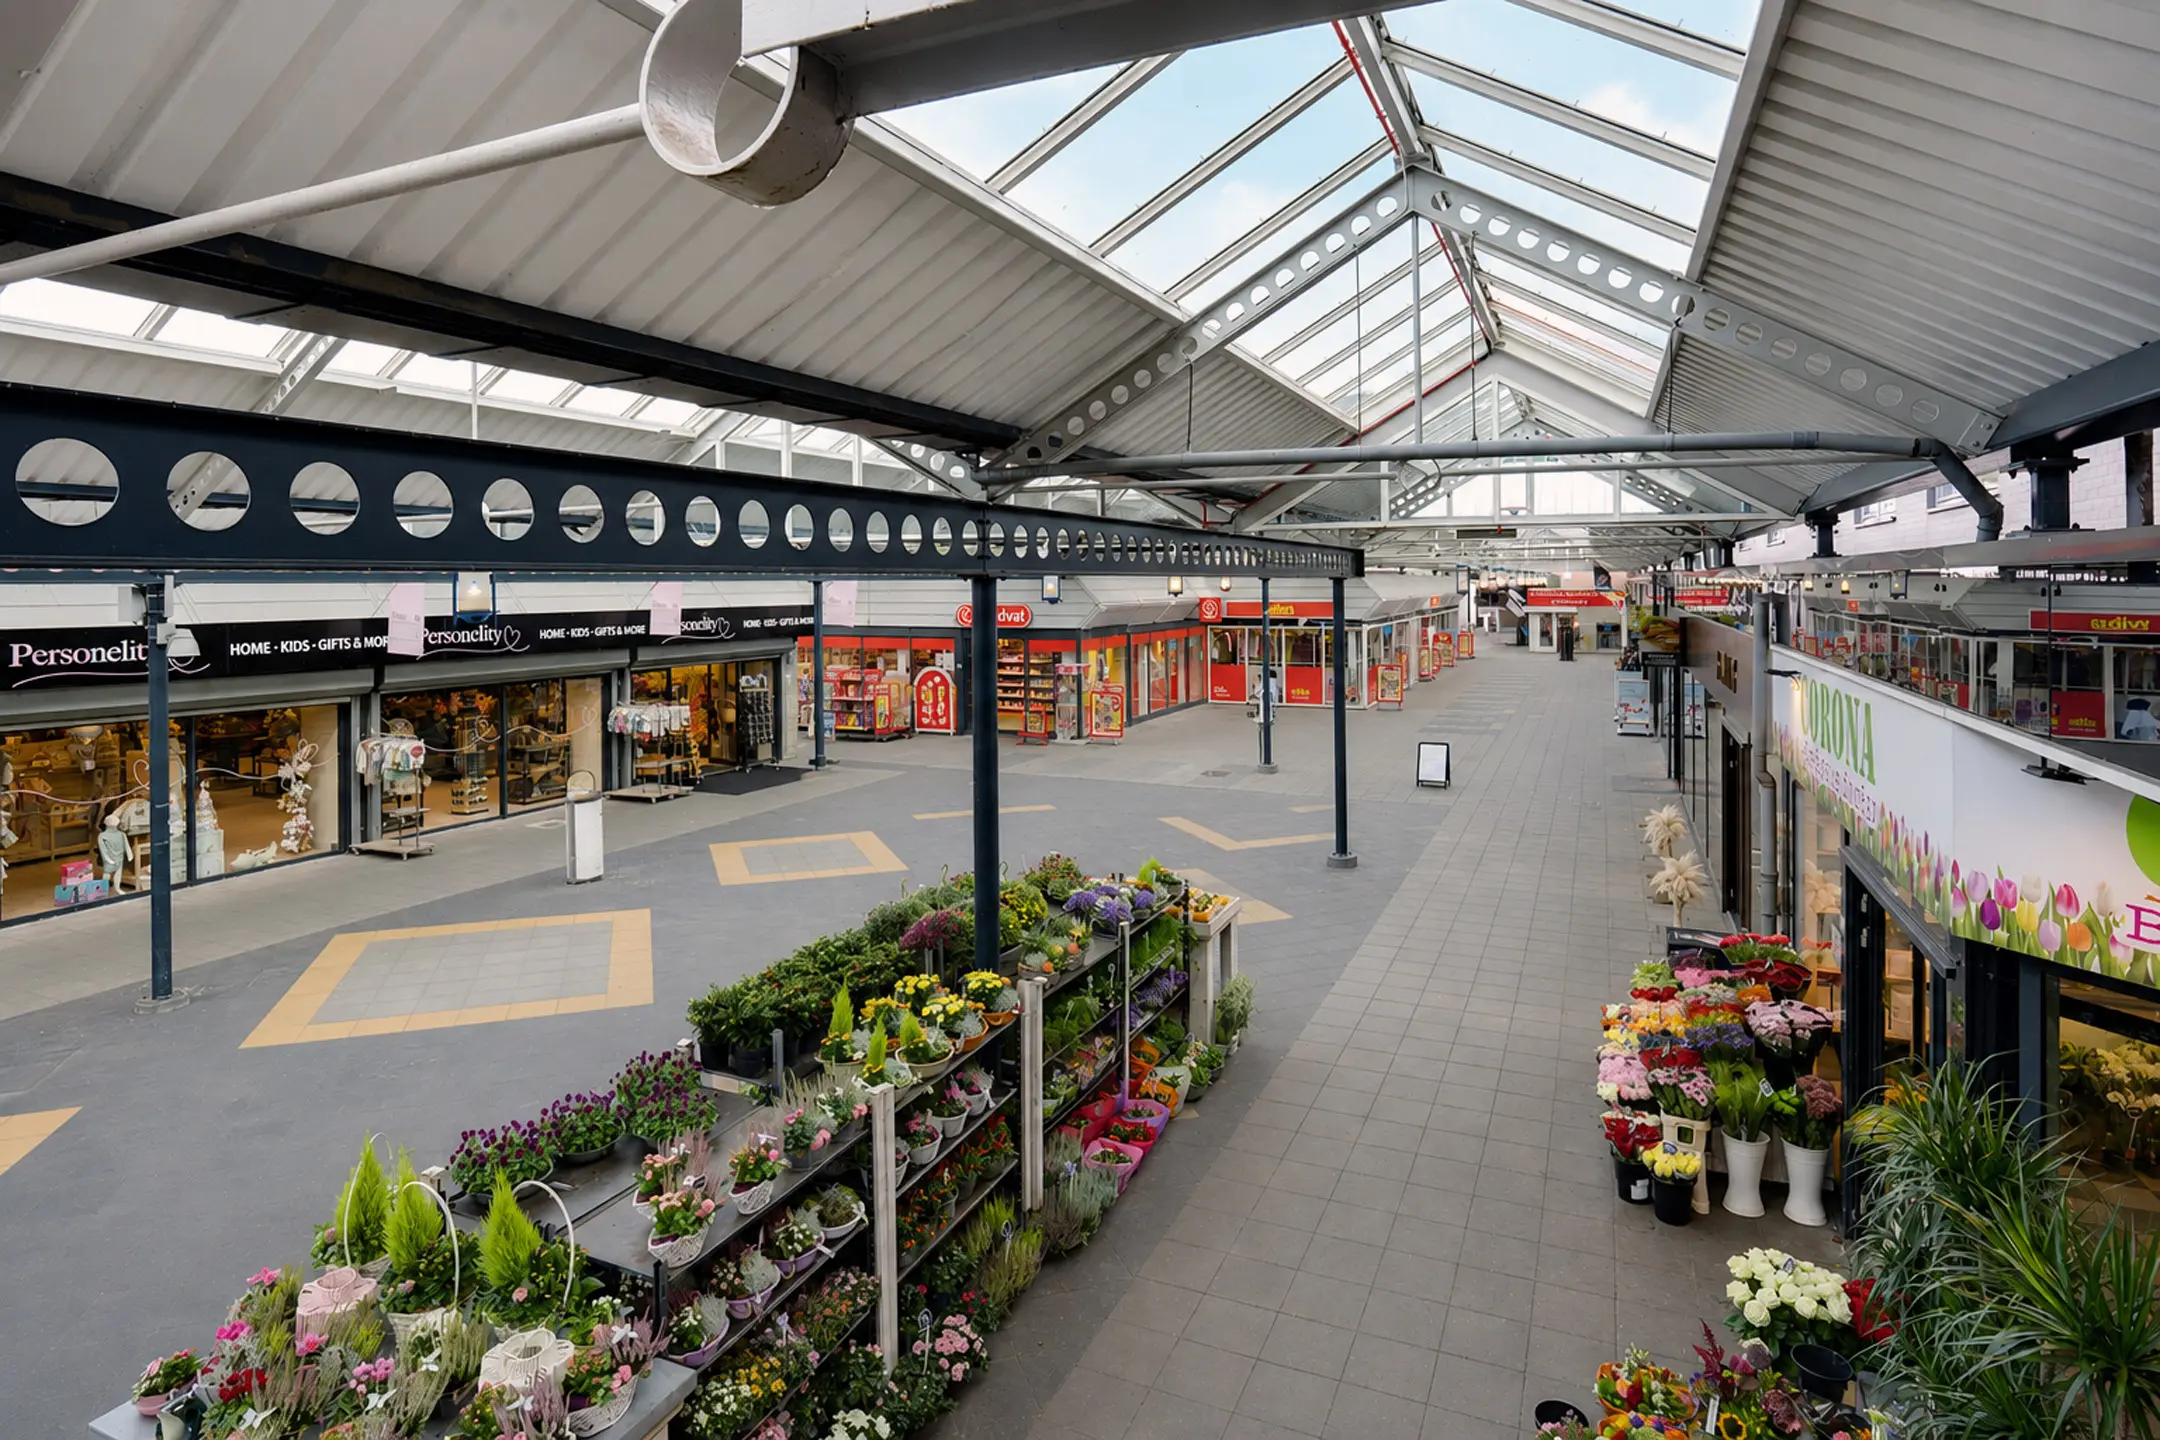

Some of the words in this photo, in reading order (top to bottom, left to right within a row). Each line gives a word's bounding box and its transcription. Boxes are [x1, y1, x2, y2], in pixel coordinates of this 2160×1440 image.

[539, 627, 566, 640] HOME
[570, 626, 590, 638] KIDS
[594, 625, 616, 637] GIFTS
[624, 624, 646, 635] MORE
[8, 639, 149, 668] Personelit
[230, 641, 272, 656] HOME
[280, 639, 311, 653] KIDS
[318, 637, 352, 650] GIFTS
[354, 636, 363, 649] &
[363, 635, 389, 649] MOR
[1800, 674, 1876, 786] CORONA
